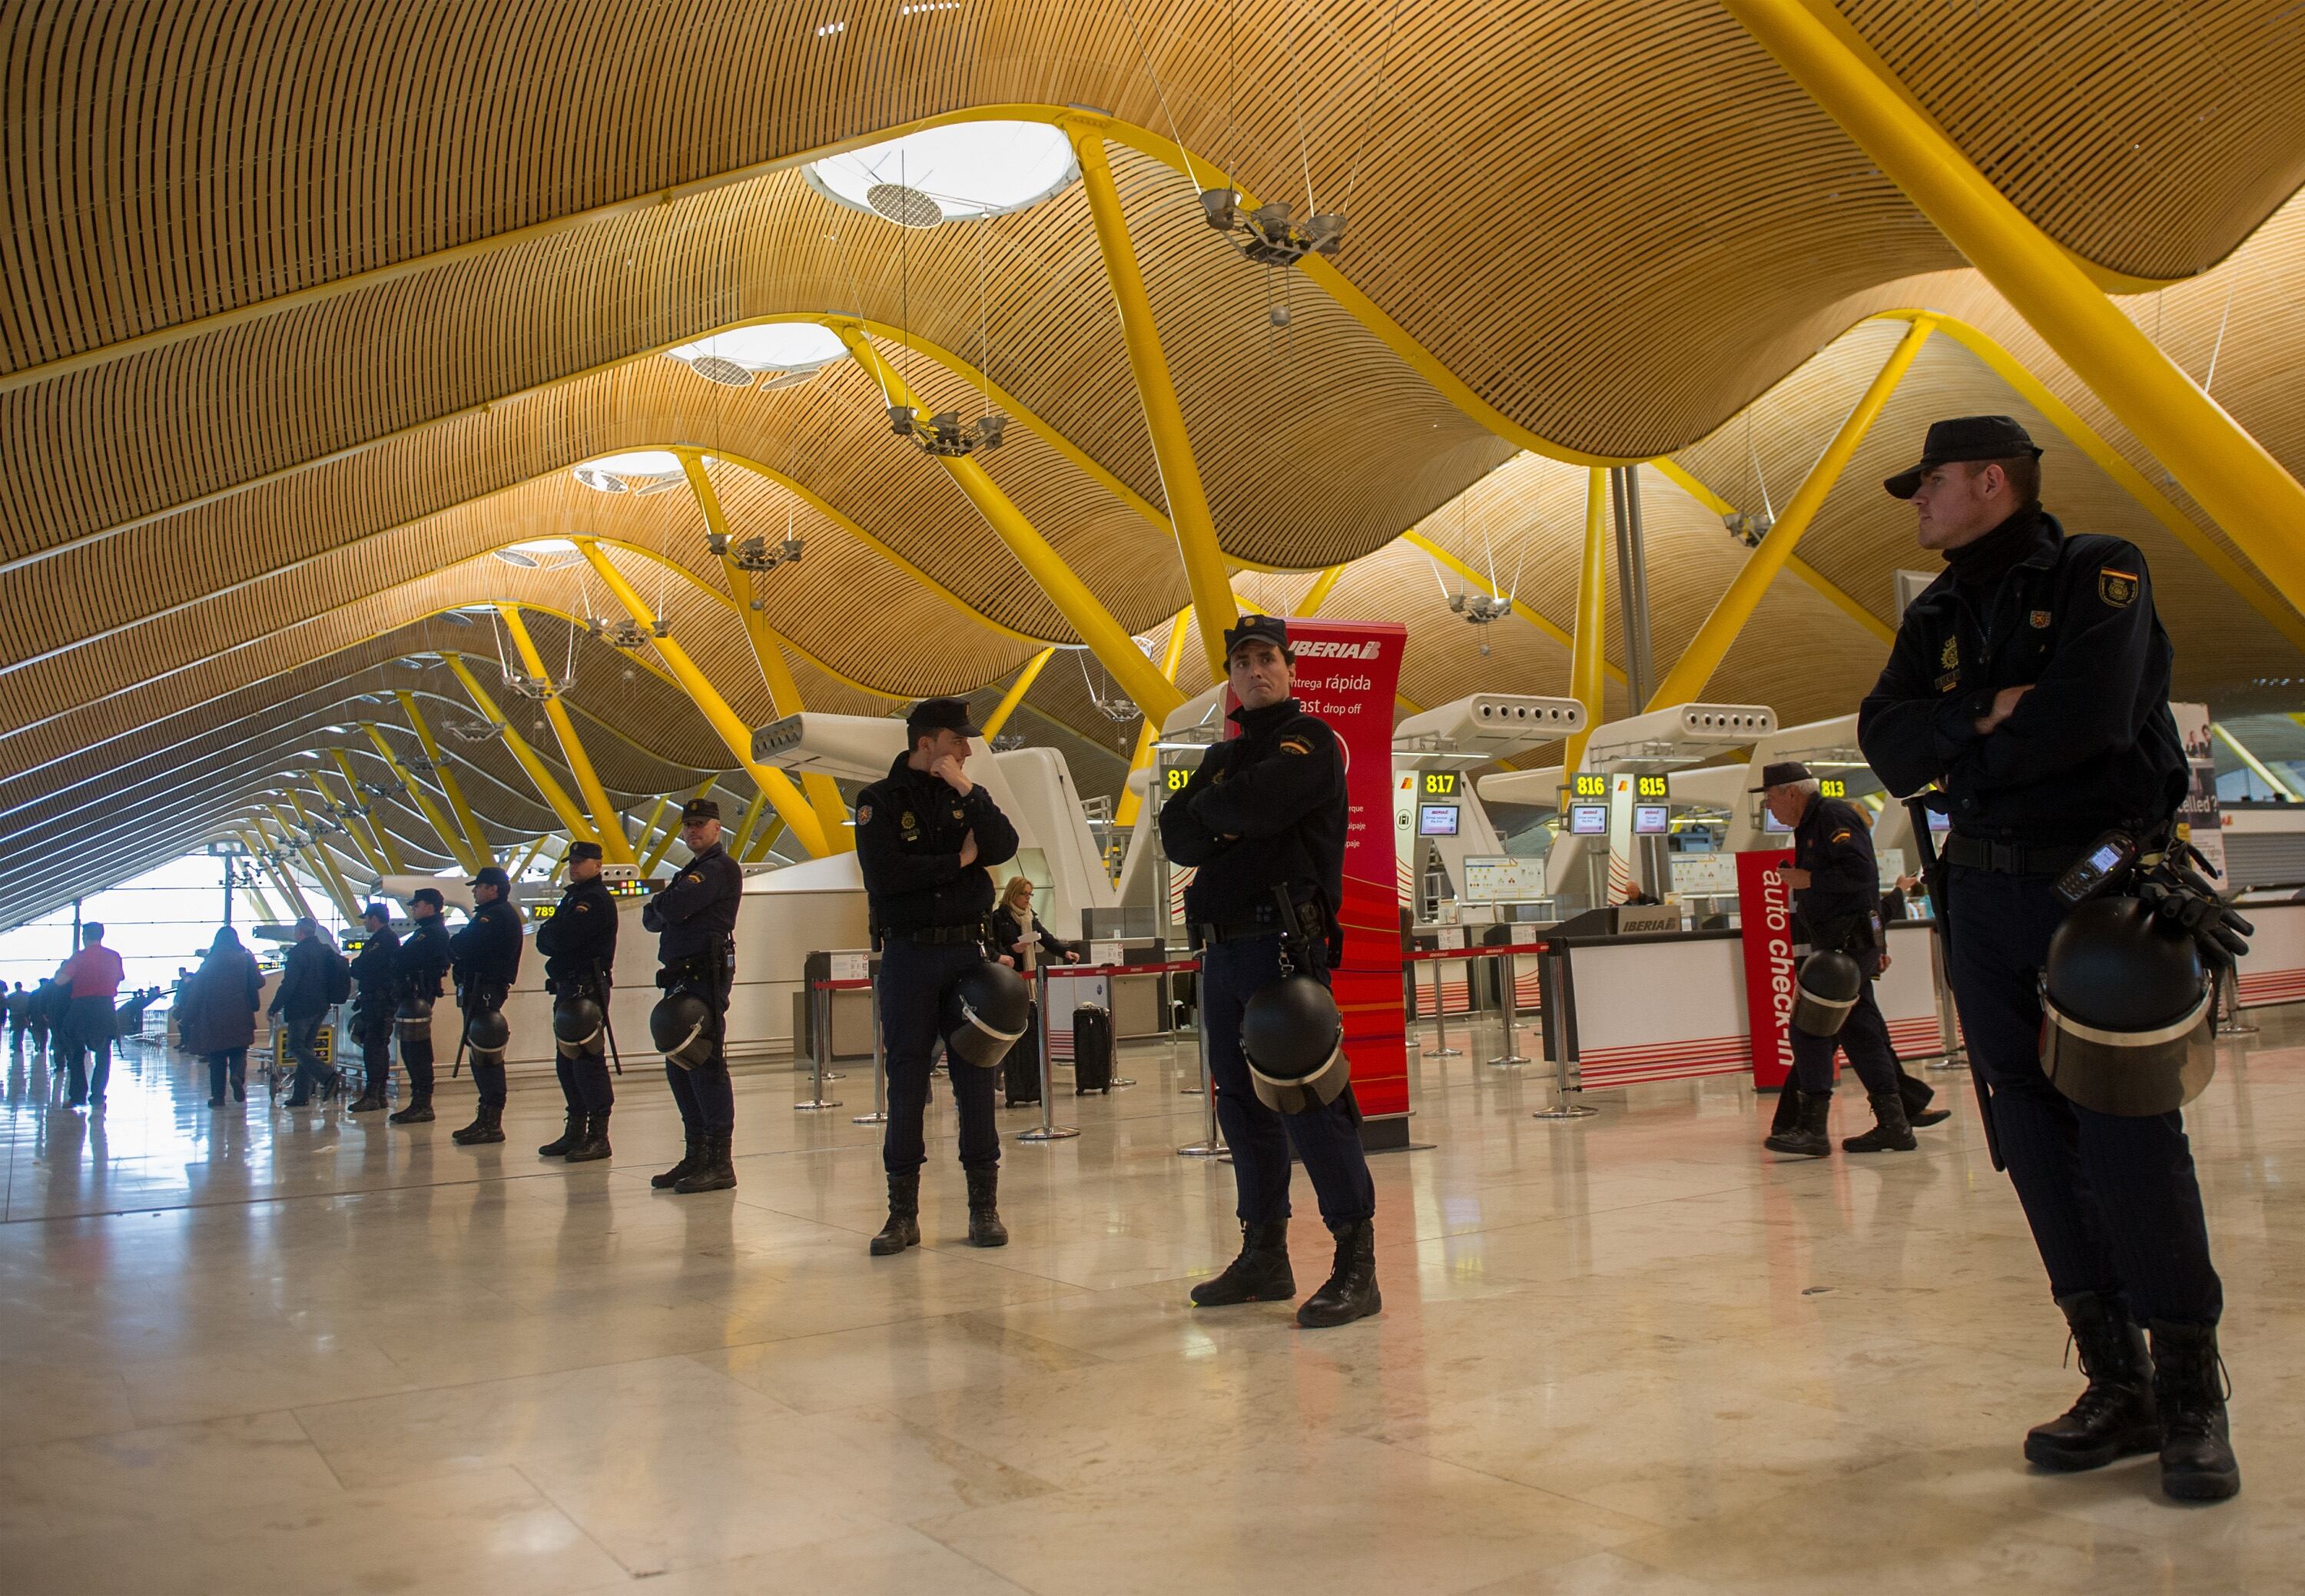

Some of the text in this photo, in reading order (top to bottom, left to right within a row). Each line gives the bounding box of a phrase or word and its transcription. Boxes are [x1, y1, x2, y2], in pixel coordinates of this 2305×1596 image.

[1288, 641, 1361, 659] IBERIA
[1291, 674, 1371, 693] ntrega rápida
[1323, 702, 1345, 716] drop
[1348, 703, 1361, 714] off
[1168, 769, 1196, 790] 81
[1426, 775, 1454, 793] 817
[1577, 776, 1604, 795] 816
[1639, 777, 1666, 796] 815
[1821, 780, 1845, 798] 813
[1348, 805, 1364, 814] rque
[1345, 839, 1360, 849] paje
[1763, 870, 1789, 931] auto
[535, 907, 556, 917] 789
[1623, 919, 1665, 932] IBERIA
[1769, 939, 1795, 1067] check-in
